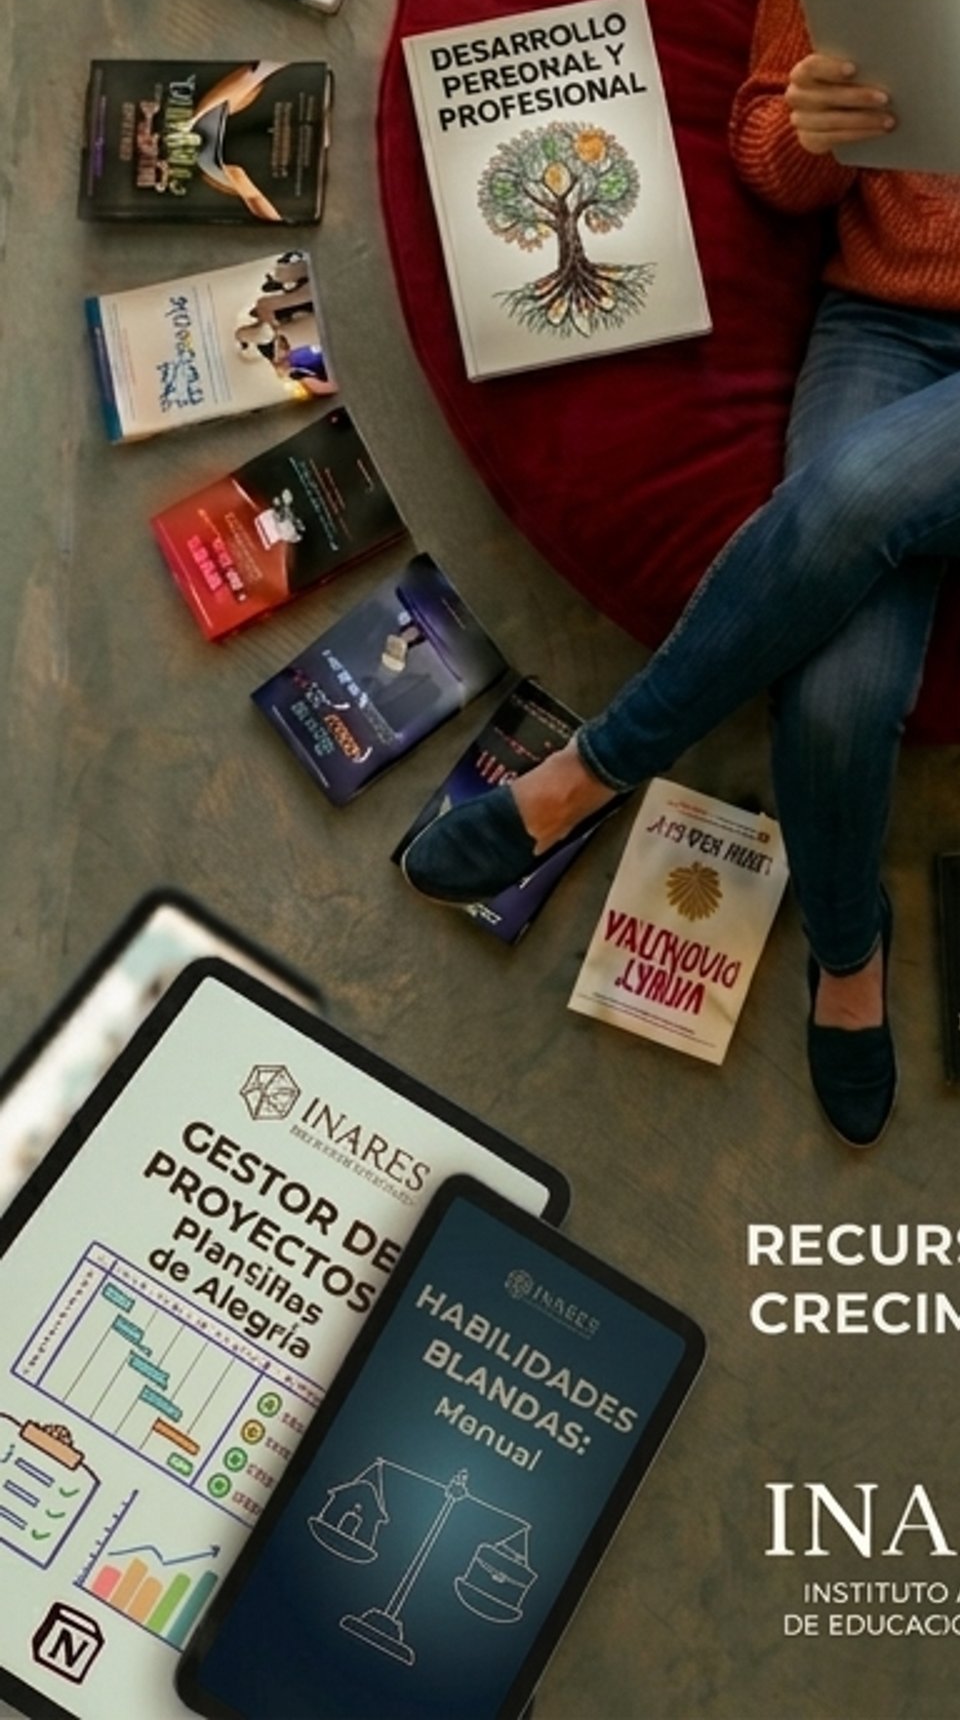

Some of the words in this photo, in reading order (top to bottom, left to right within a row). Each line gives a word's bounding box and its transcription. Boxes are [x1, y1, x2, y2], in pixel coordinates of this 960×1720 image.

[430, 12, 627, 72] DESARROLLO
[607, 42, 626, 67] Y
[438, 72, 648, 131] PROFESIONAL
[301, 1097, 431, 1192] INARES
[143, 1150, 376, 1314] PROYECTOS
[182, 1121, 338, 1236] GESTOR
[341, 1220, 402, 1274] DE
[148, 1247, 191, 1282] de
[415, 1283, 638, 1434] HABILIDADES
[422, 1339, 591, 1456] BLANDAS:
